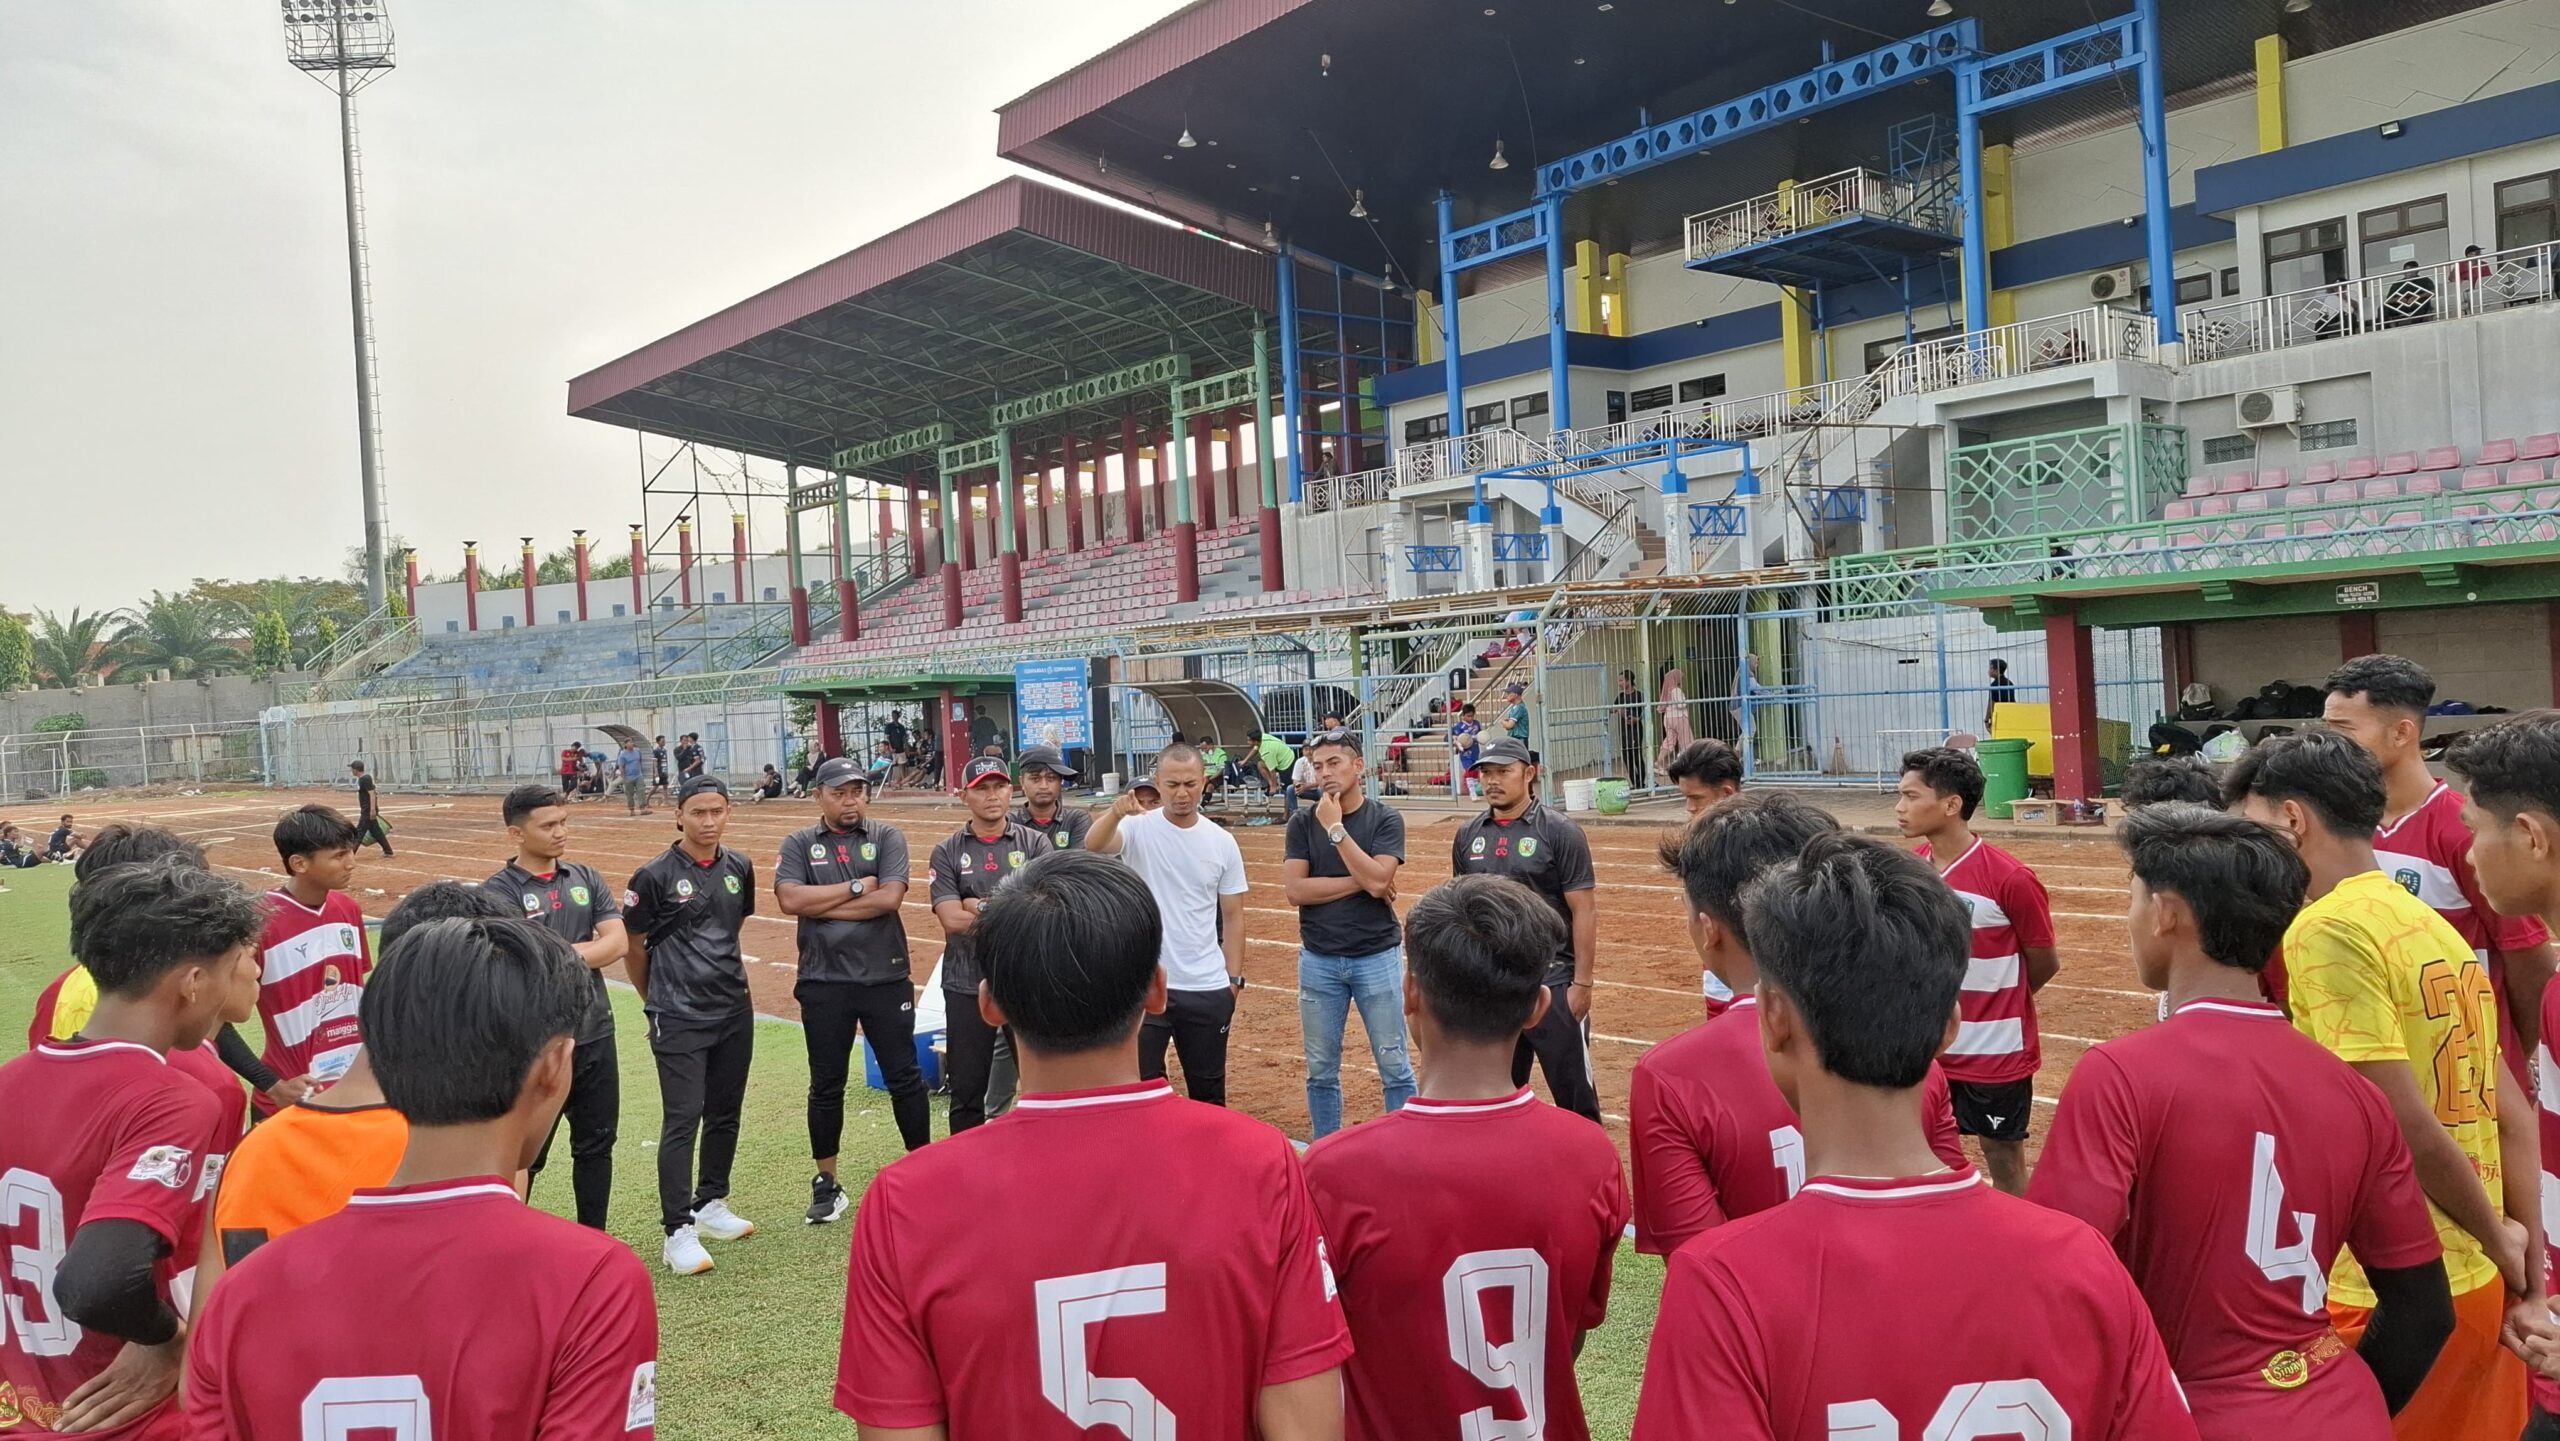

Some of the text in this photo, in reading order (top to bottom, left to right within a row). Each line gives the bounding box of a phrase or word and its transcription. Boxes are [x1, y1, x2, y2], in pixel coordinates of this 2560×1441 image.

[0, 1167, 83, 1357] 3
[2245, 1131, 2328, 1315] 4
[1035, 1261, 1176, 1441] 5
[1443, 1247, 1549, 1441] 9
